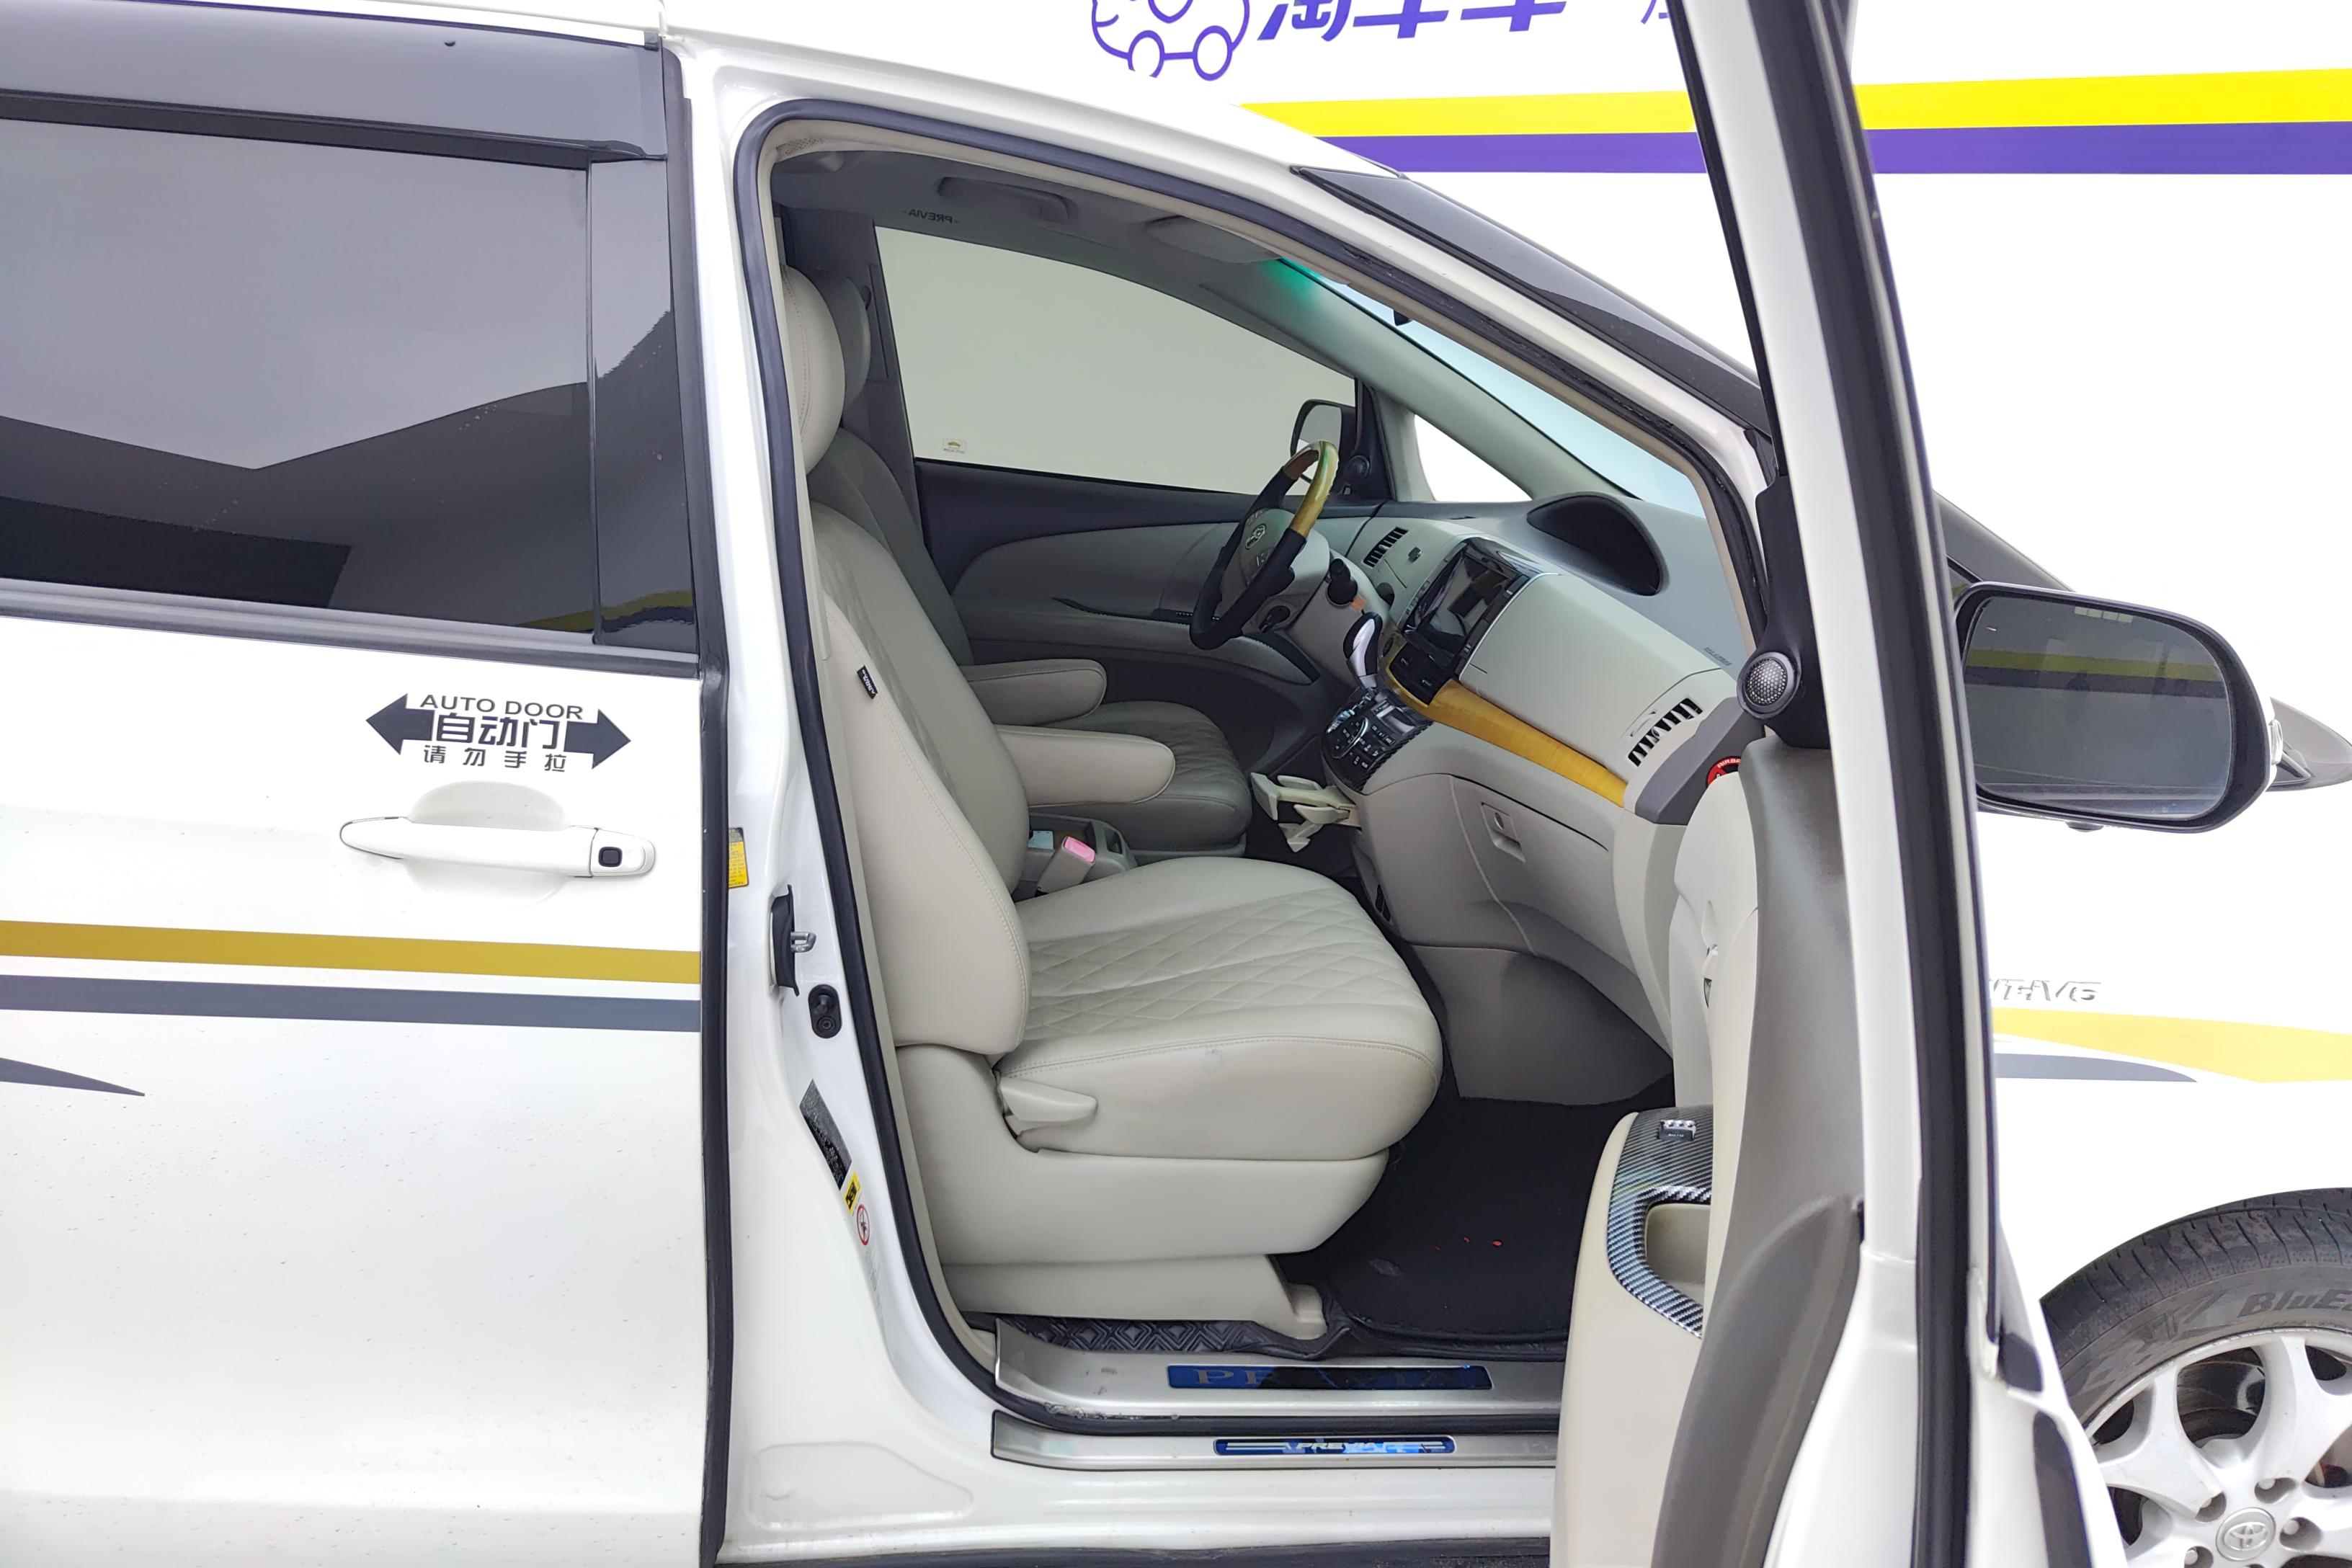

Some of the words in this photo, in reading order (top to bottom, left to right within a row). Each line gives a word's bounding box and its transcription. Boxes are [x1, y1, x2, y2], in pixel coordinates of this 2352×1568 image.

[420, 695, 496, 713] AUTO
[504, 700, 583, 720] DOOR
[436, 713, 560, 749] 自动门
[424, 745, 567, 772] 请勿手拉
[2237, 1288, 2352, 1318] BluE
